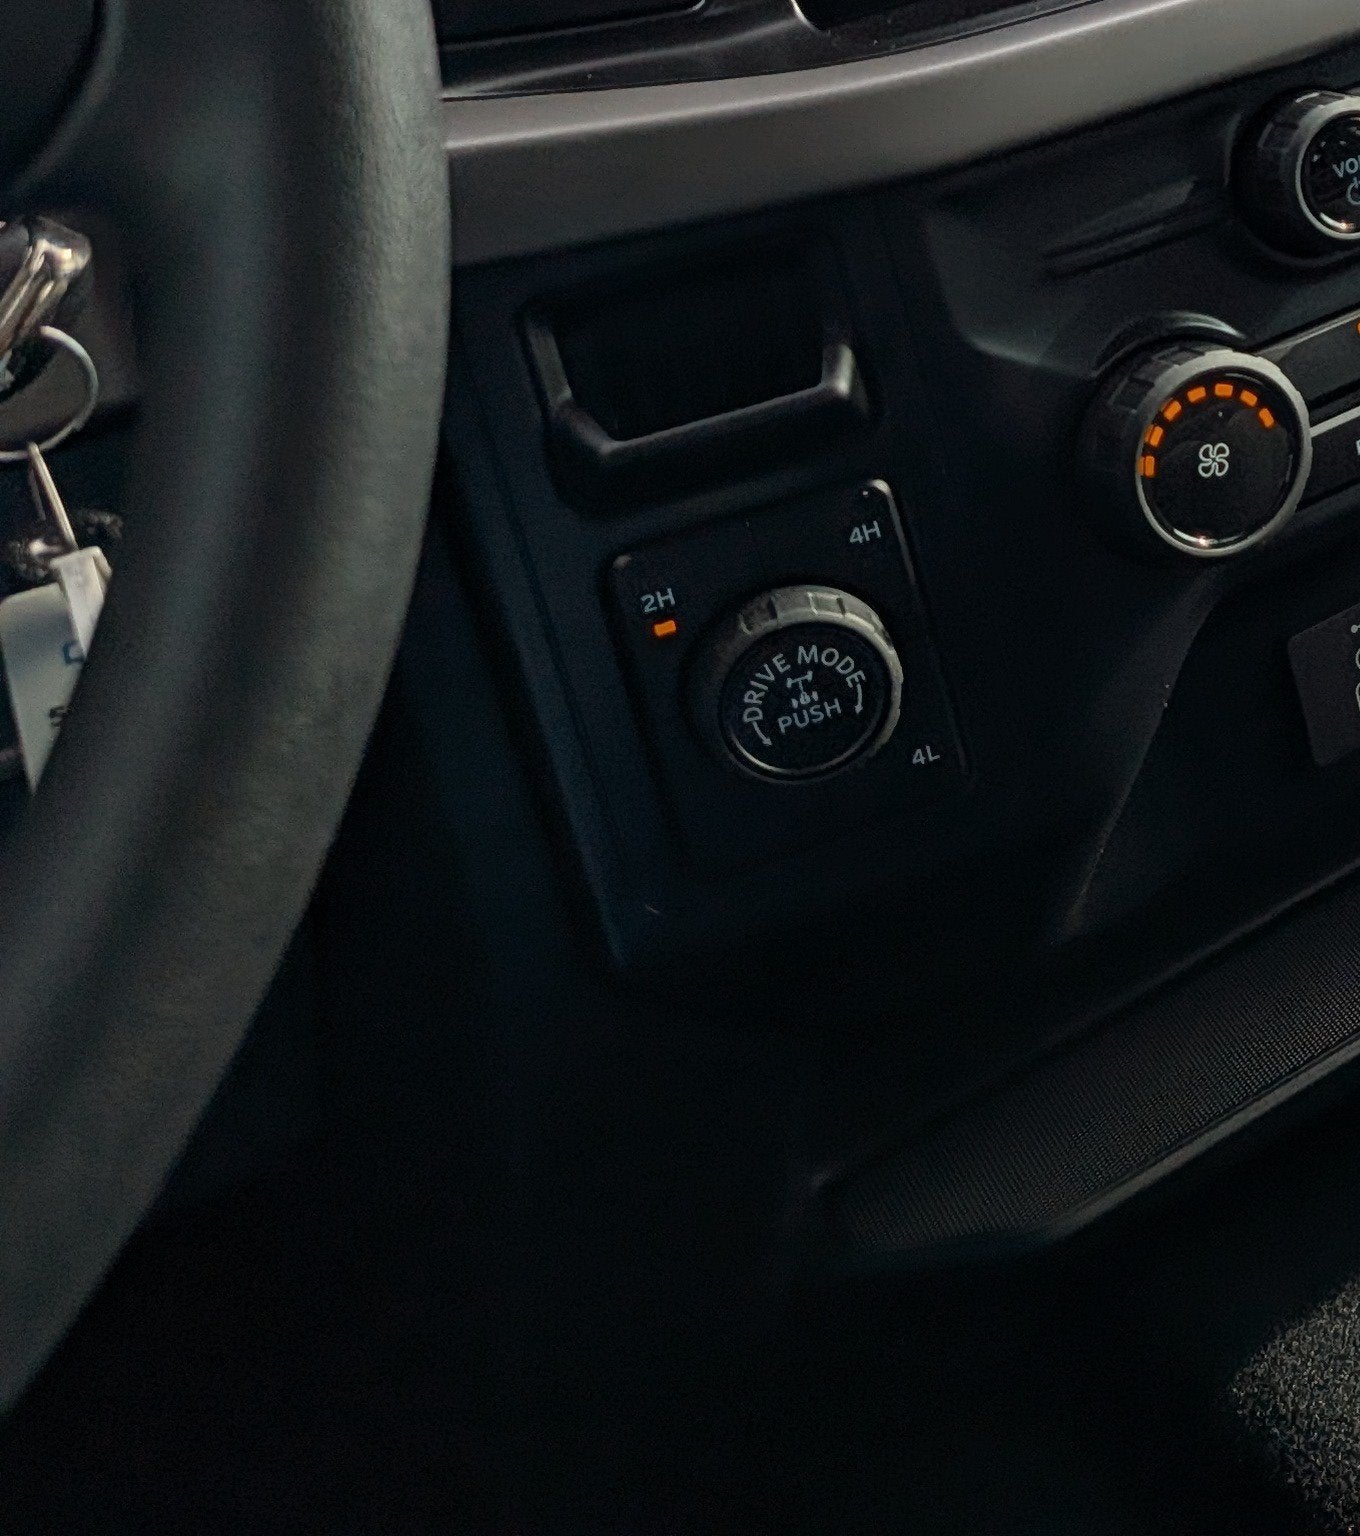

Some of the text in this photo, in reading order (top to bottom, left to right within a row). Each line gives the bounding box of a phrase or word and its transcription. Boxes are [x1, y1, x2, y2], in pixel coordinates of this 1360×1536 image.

[848, 519, 882, 545] 4H
[640, 587, 677, 614] 2H
[741, 644, 867, 723] DRIVE MODE
[776, 696, 843, 735] PUSH
[911, 744, 942, 766] 4L
